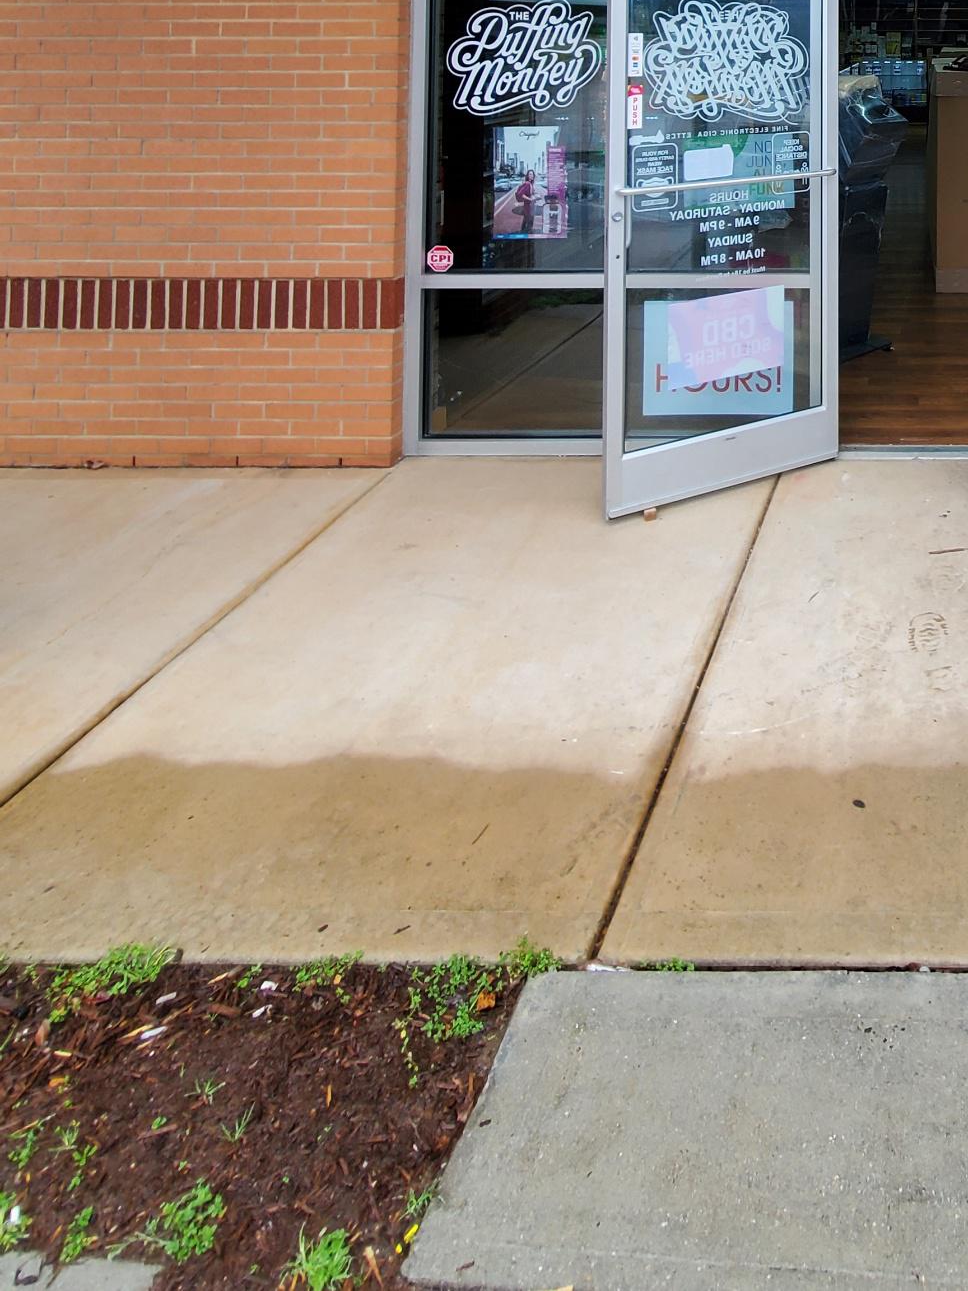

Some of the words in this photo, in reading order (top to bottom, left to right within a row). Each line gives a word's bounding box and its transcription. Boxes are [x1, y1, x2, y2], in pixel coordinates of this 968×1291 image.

[509, 11, 530, 21] THE
[461, 2, 589, 70] Puffing
[451, 41, 597, 110] Monkey
[430, 254, 451, 262] CPI
[656, 363, 781, 393] HURS!
